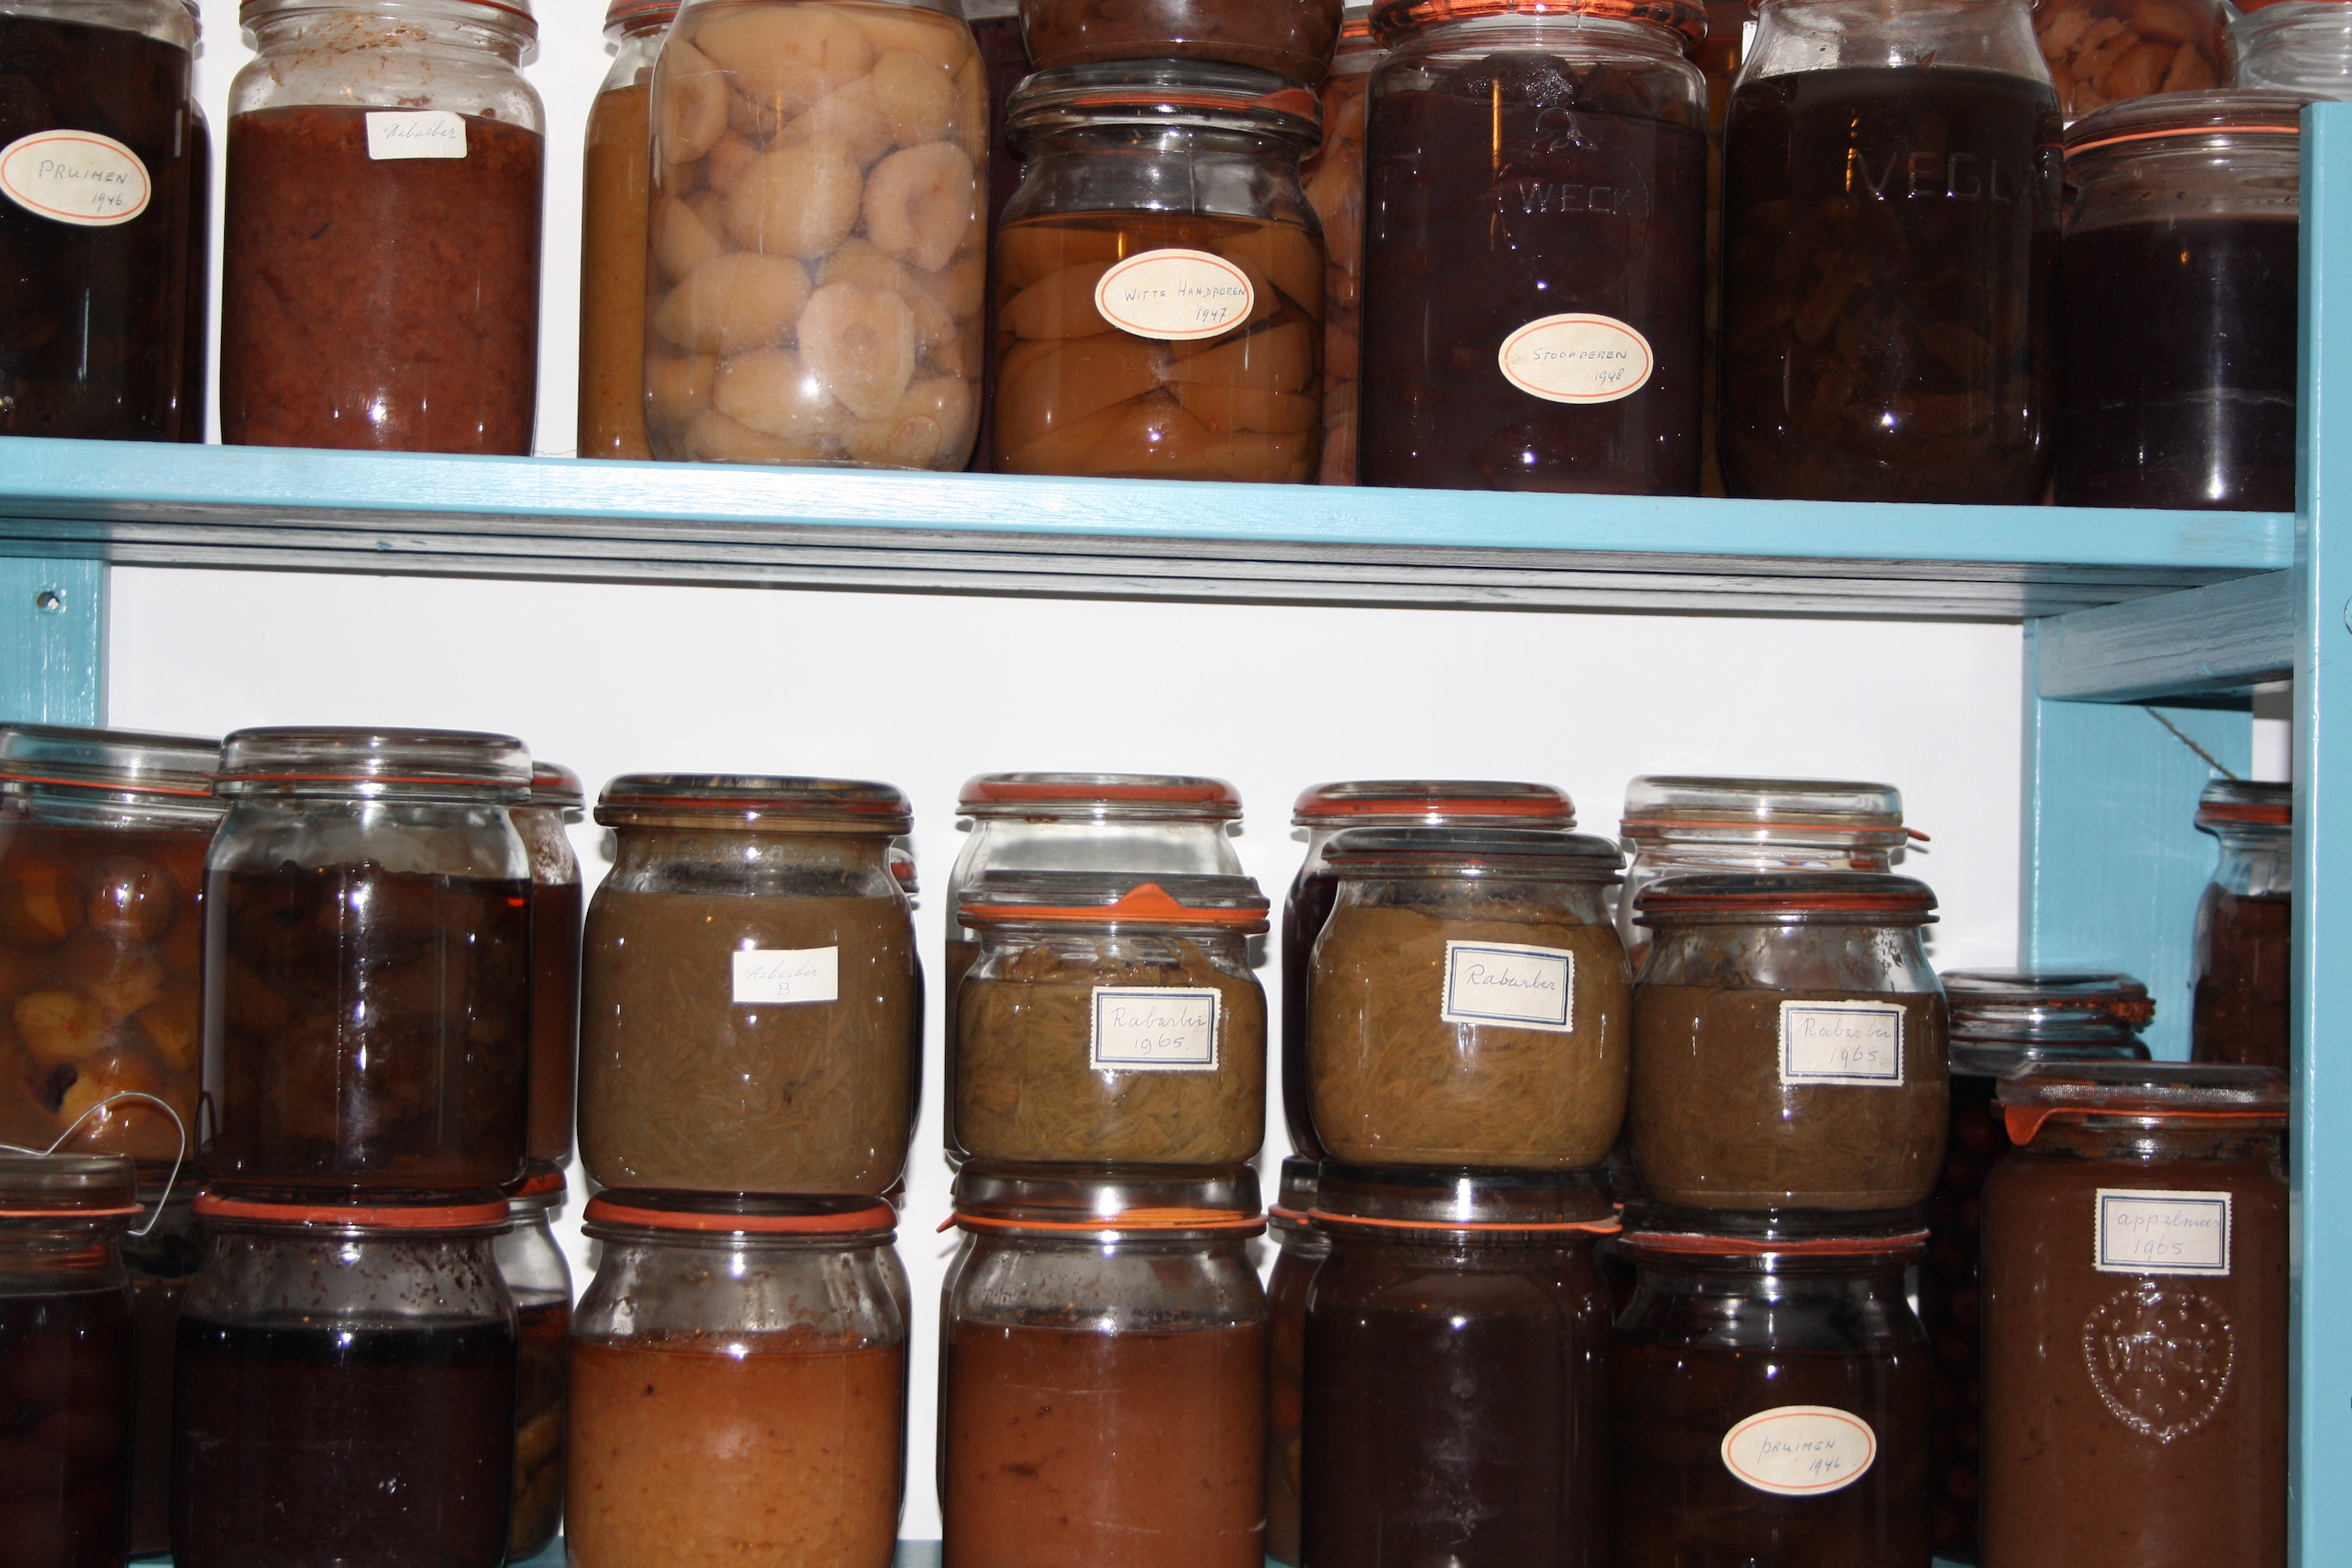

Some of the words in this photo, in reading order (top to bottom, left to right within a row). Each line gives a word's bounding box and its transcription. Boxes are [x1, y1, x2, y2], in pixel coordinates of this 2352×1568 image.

[1518, 182, 1632, 216] WECK
[778, 982, 791, 996] B
[1463, 963, 1556, 989] Rabarber
[1110, 1005, 1208, 1028] Rabarber
[2134, 1235, 2183, 1261] 1965
[2103, 1335, 2218, 1374] WECK
